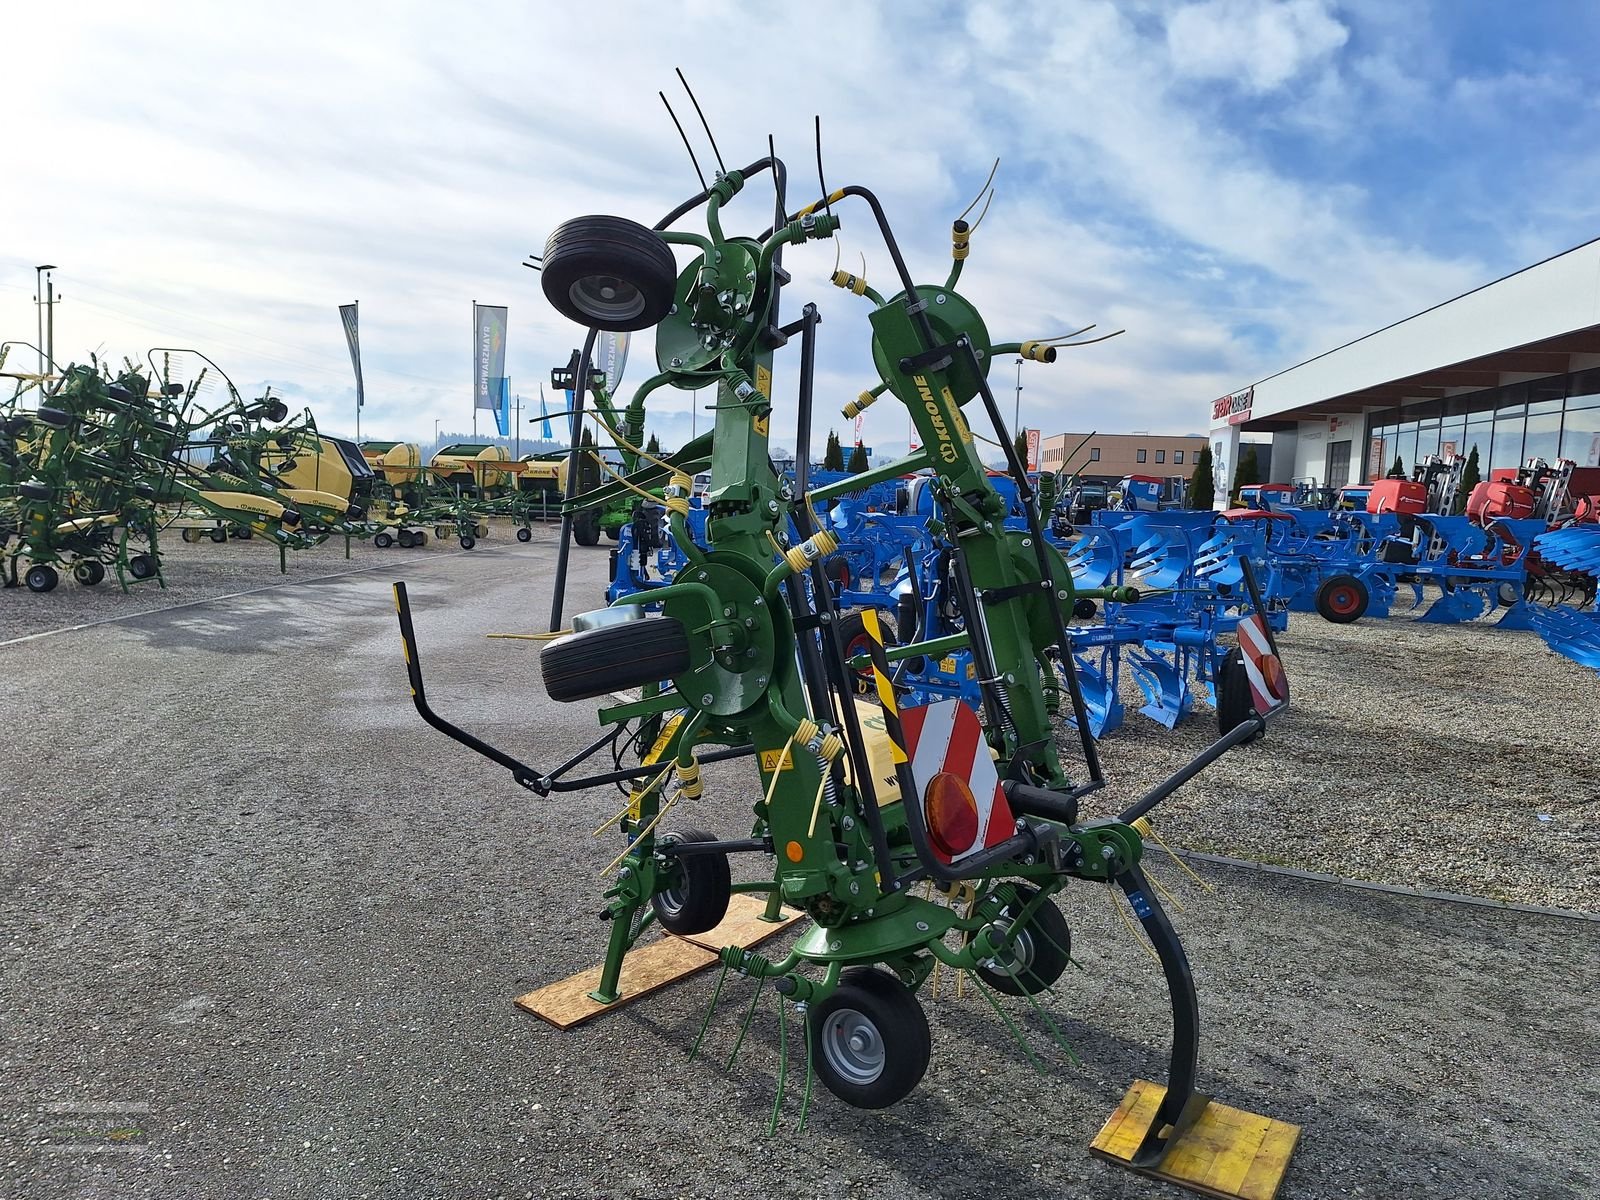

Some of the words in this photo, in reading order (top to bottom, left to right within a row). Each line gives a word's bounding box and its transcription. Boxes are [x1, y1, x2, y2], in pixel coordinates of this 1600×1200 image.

[480, 326, 491, 396] SCHWARZMAYR
[607, 333, 616, 393] CHWARZMAY
[912, 375, 951, 441] KRONE
[247, 505, 270, 514] KRONE
